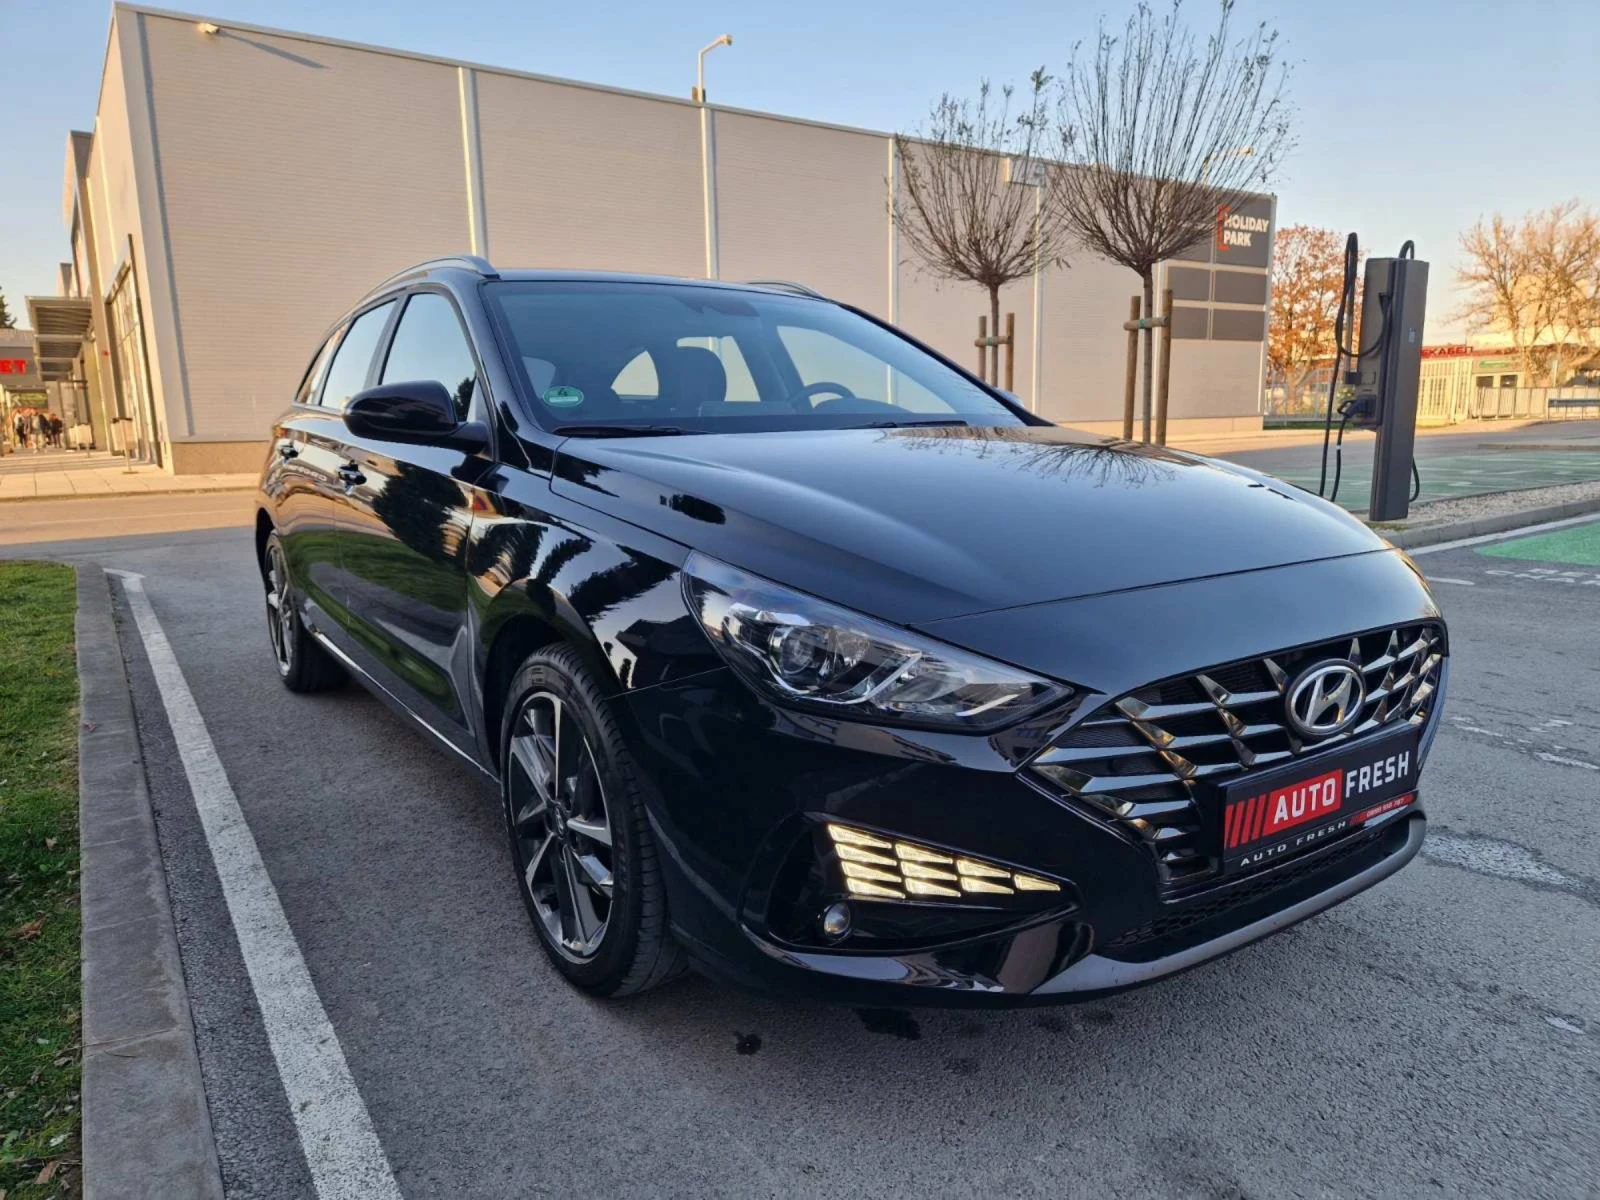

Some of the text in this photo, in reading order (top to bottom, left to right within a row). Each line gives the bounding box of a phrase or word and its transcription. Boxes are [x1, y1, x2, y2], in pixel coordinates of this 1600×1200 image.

[1223, 230, 1252, 247] PARK
[1224, 212, 1269, 233] HOLIDAY
[1273, 777, 1336, 825] AUTO
[1345, 751, 1410, 798] FRESH
[1240, 820, 1347, 867] AUTO FRESH
